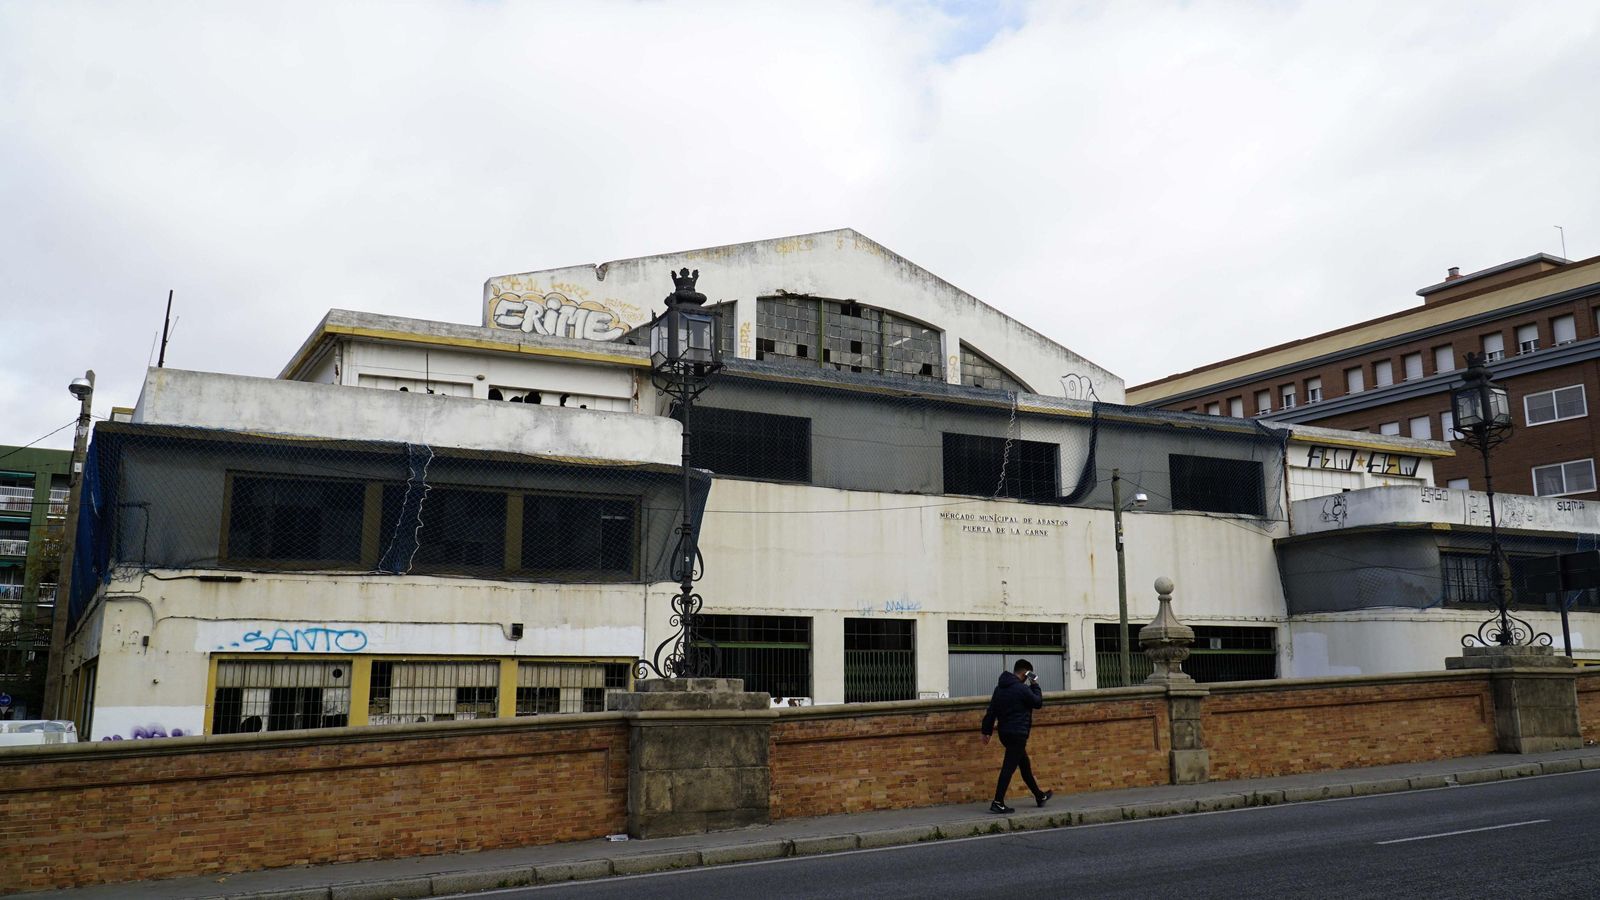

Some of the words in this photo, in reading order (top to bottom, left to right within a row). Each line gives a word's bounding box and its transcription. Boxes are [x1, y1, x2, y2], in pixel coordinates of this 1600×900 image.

[939, 512, 975, 520] MERCADO
[1037, 518, 1069, 527] ABASTOS
[962, 524, 992, 533] PUERTA
[996, 526, 1006, 534] DE
[1025, 529, 1049, 537] CARNE
[243, 627, 368, 651] SANTO
